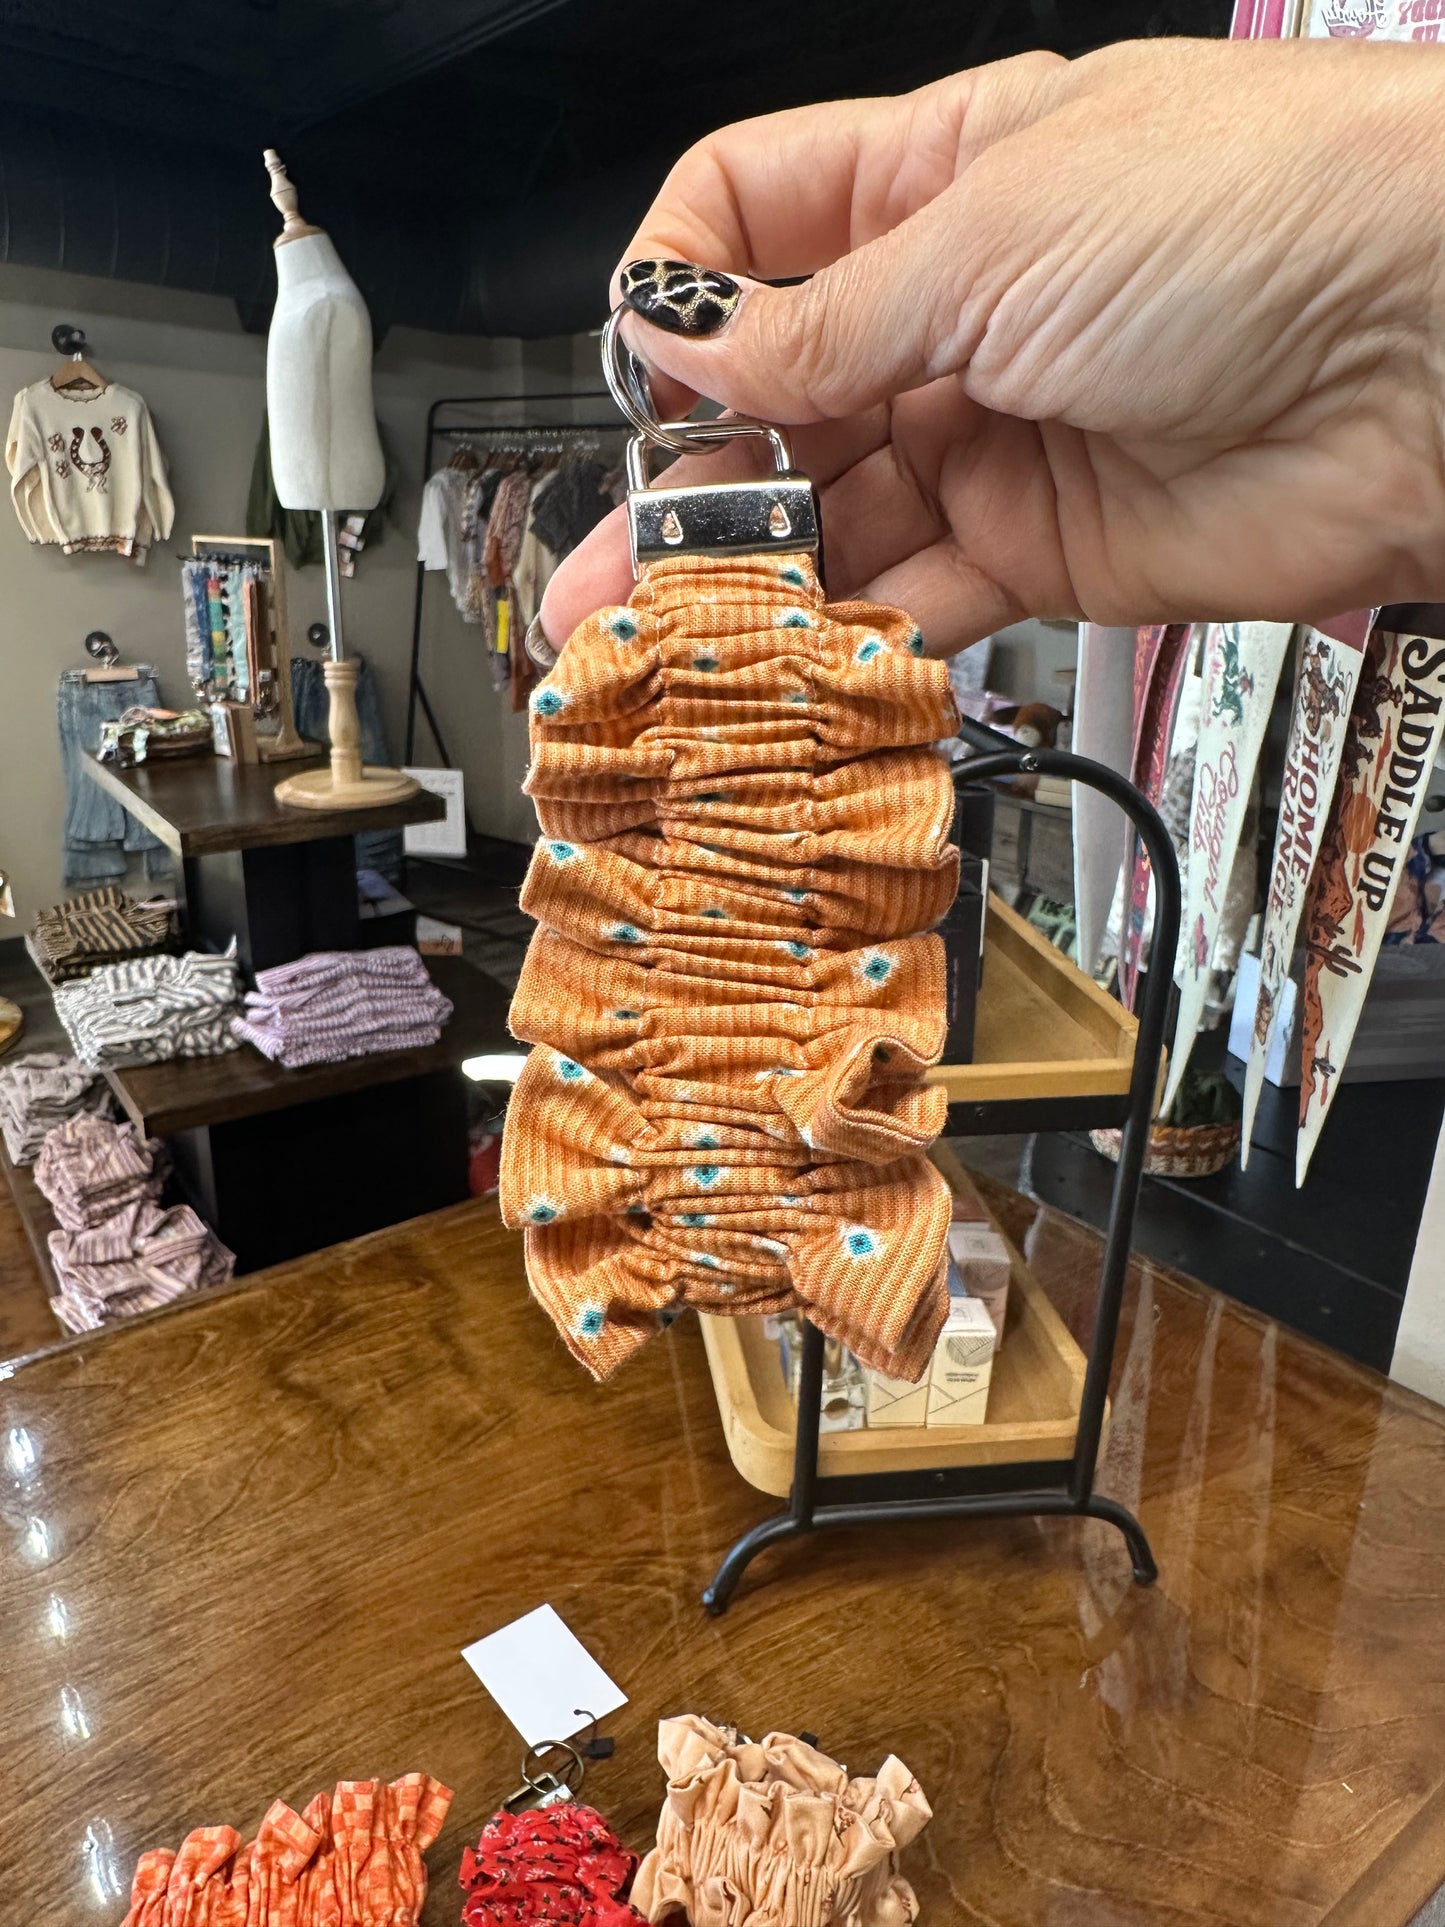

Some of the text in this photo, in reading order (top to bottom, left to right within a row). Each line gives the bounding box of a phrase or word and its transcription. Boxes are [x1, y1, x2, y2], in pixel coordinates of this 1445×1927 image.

[1273, 761, 1300, 920] RANGE
[1292, 733, 1319, 885] HOME
[1358, 638, 1445, 911] SADDLE UP
